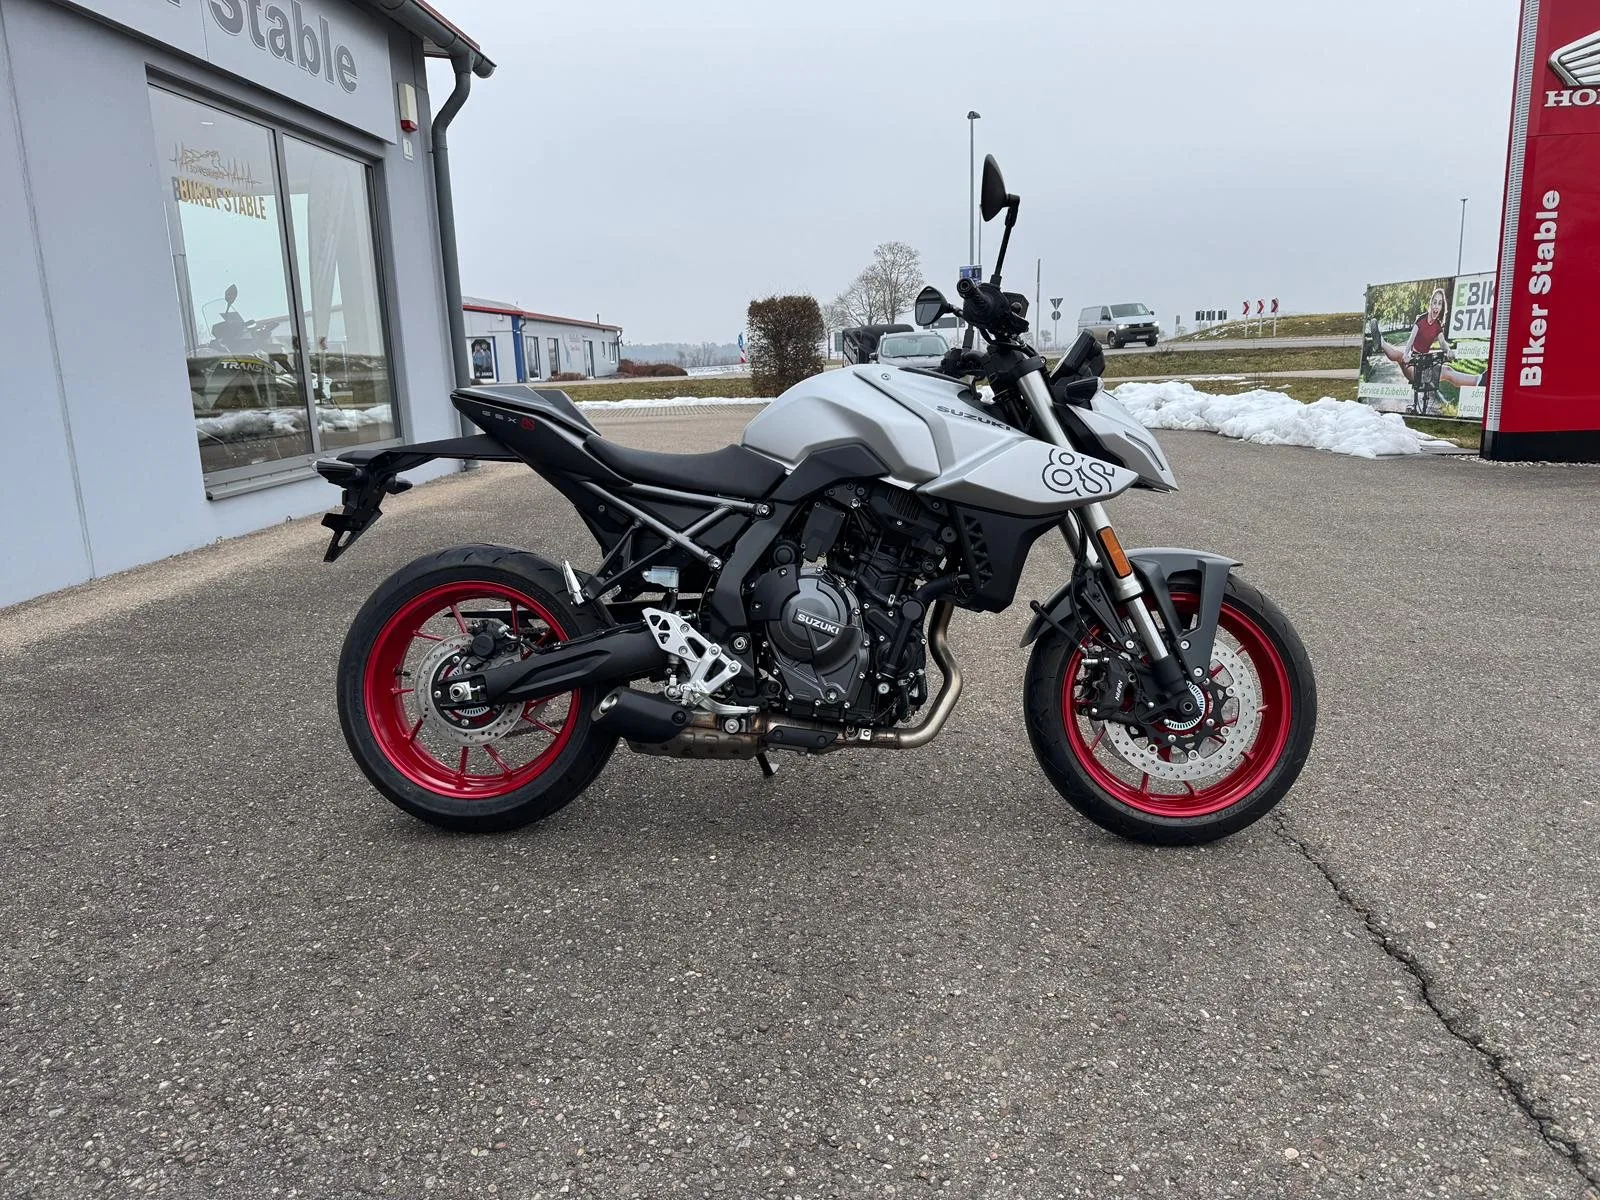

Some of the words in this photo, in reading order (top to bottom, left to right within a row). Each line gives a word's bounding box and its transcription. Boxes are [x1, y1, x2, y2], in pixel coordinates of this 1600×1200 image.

[1544, 88, 1600, 107] HO
[222, 188, 267, 220] STABLE
[1528, 189, 1560, 295] Stable
[1519, 303, 1549, 388] Biker
[937, 405, 1011, 431] SUZUKI
[797, 613, 840, 635] SUZUKI
